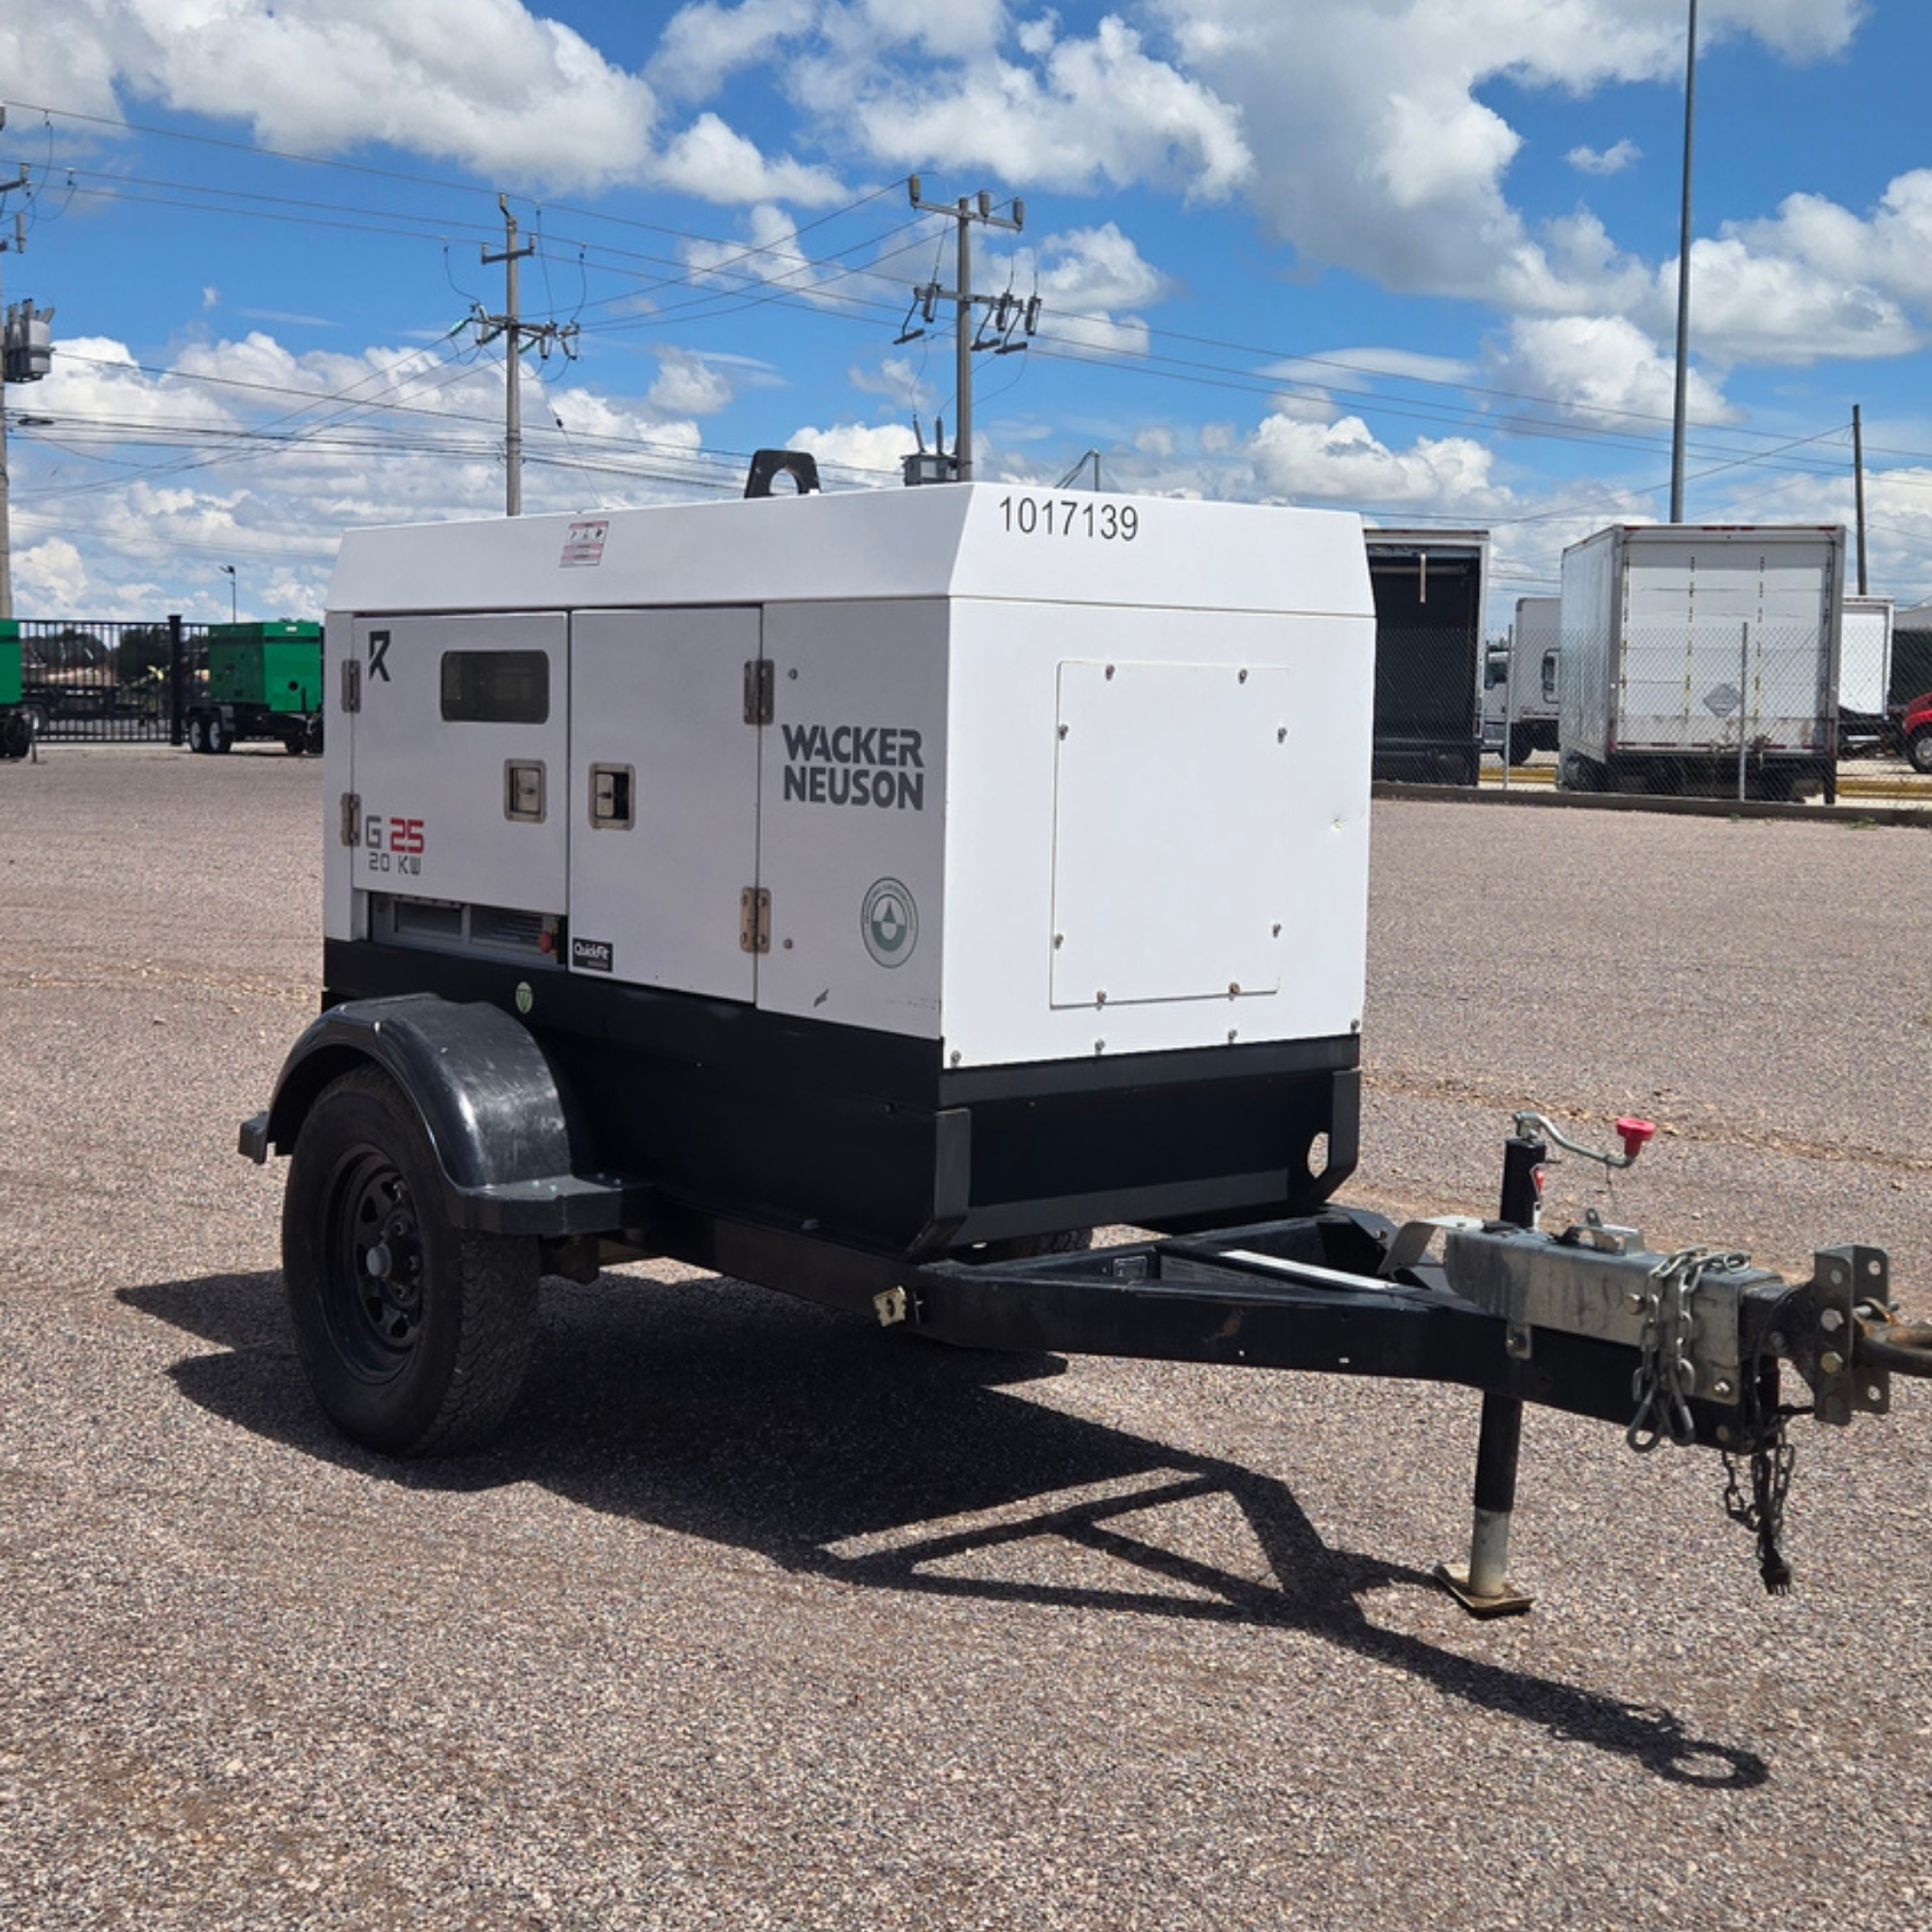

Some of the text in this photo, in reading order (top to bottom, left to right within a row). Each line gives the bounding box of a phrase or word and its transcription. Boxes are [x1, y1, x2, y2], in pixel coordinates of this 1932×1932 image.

[999, 496, 1139, 541] 1017139
[781, 724, 924, 767] WACKER
[783, 765, 924, 810] NEUSON
[365, 814, 425, 854] G 25
[368, 851, 422, 876] 20 KW
